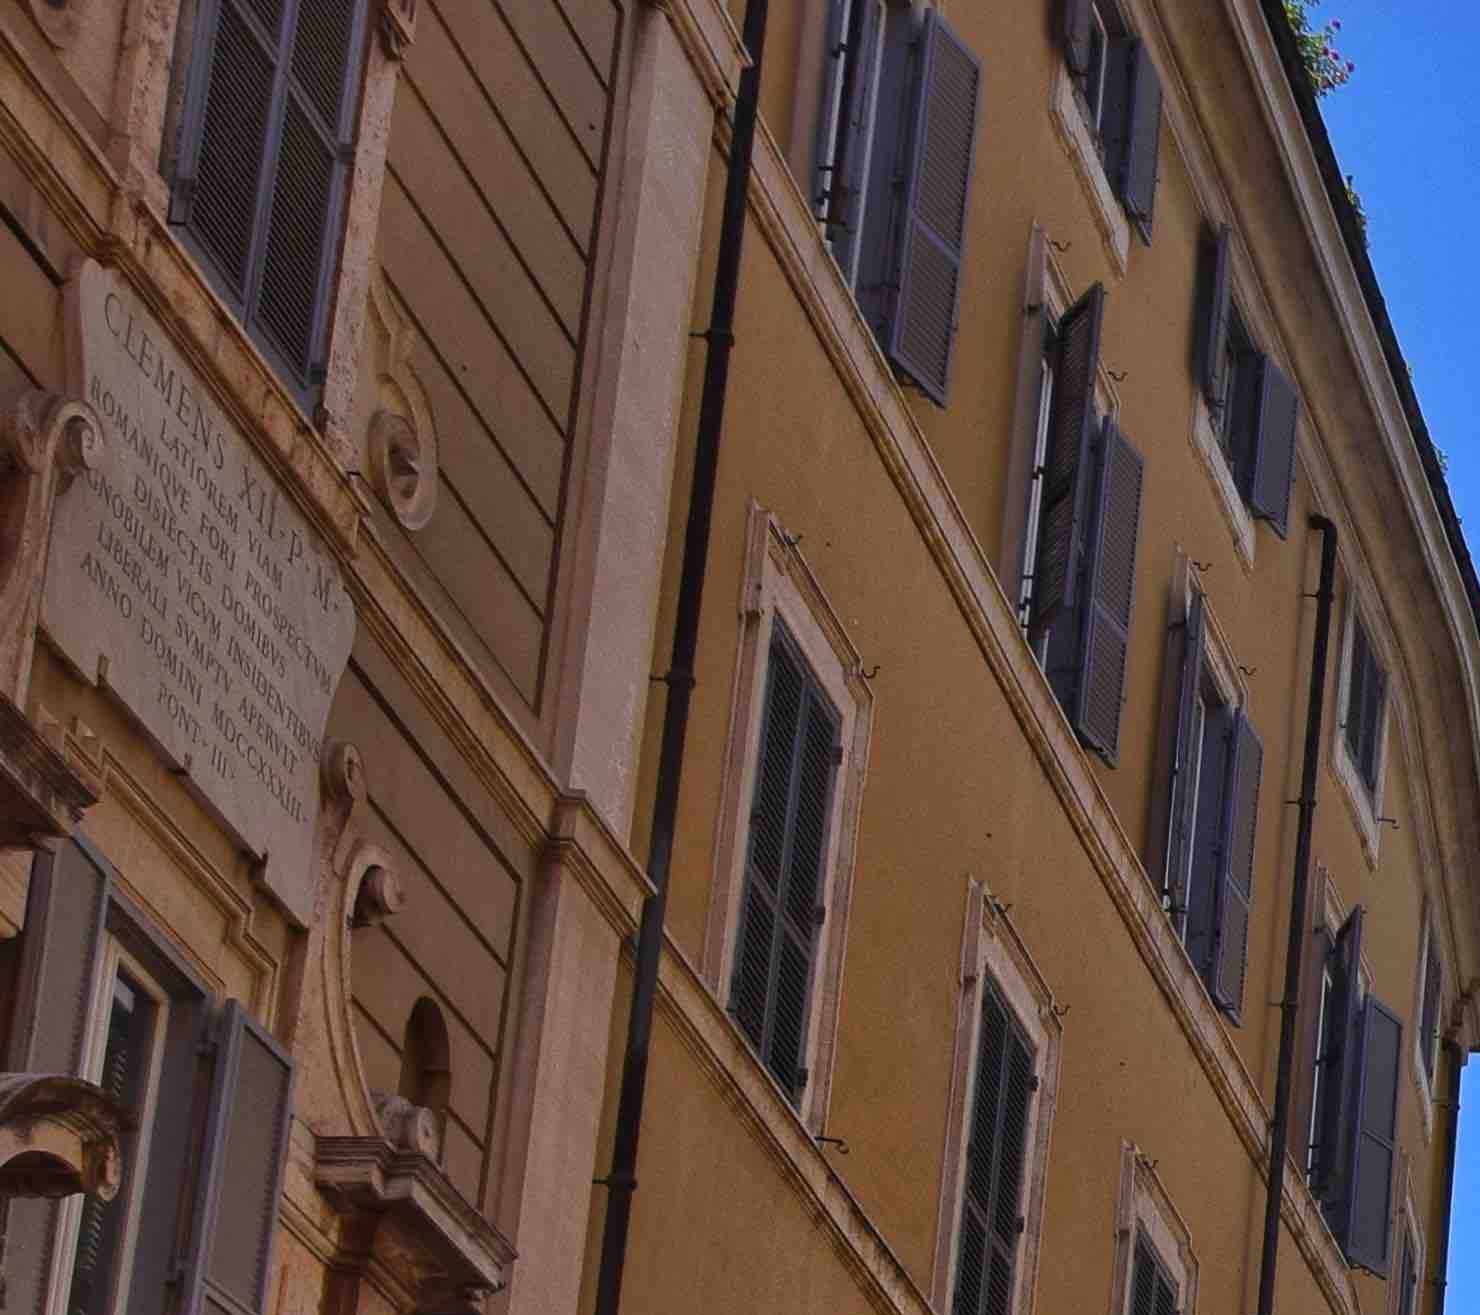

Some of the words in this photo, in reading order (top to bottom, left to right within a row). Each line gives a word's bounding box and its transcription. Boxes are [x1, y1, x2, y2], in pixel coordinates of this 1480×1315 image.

[104, 292, 226, 471] CLEMENS
[133, 474, 212, 586] DISIECTIS
[221, 583, 287, 680] DOMIBVS
[159, 416, 239, 534] LATIOREM
[248, 528, 282, 593] VIAM
[199, 511, 237, 572] FORI
[80, 552, 132, 619] ANNO
[141, 615, 202, 706] DOMINI
[97, 519, 168, 619] LIBERALI
[175, 613, 233, 694] SVMPTV
[239, 696, 298, 775] APERVIT
[176, 568, 222, 643] VICVM
